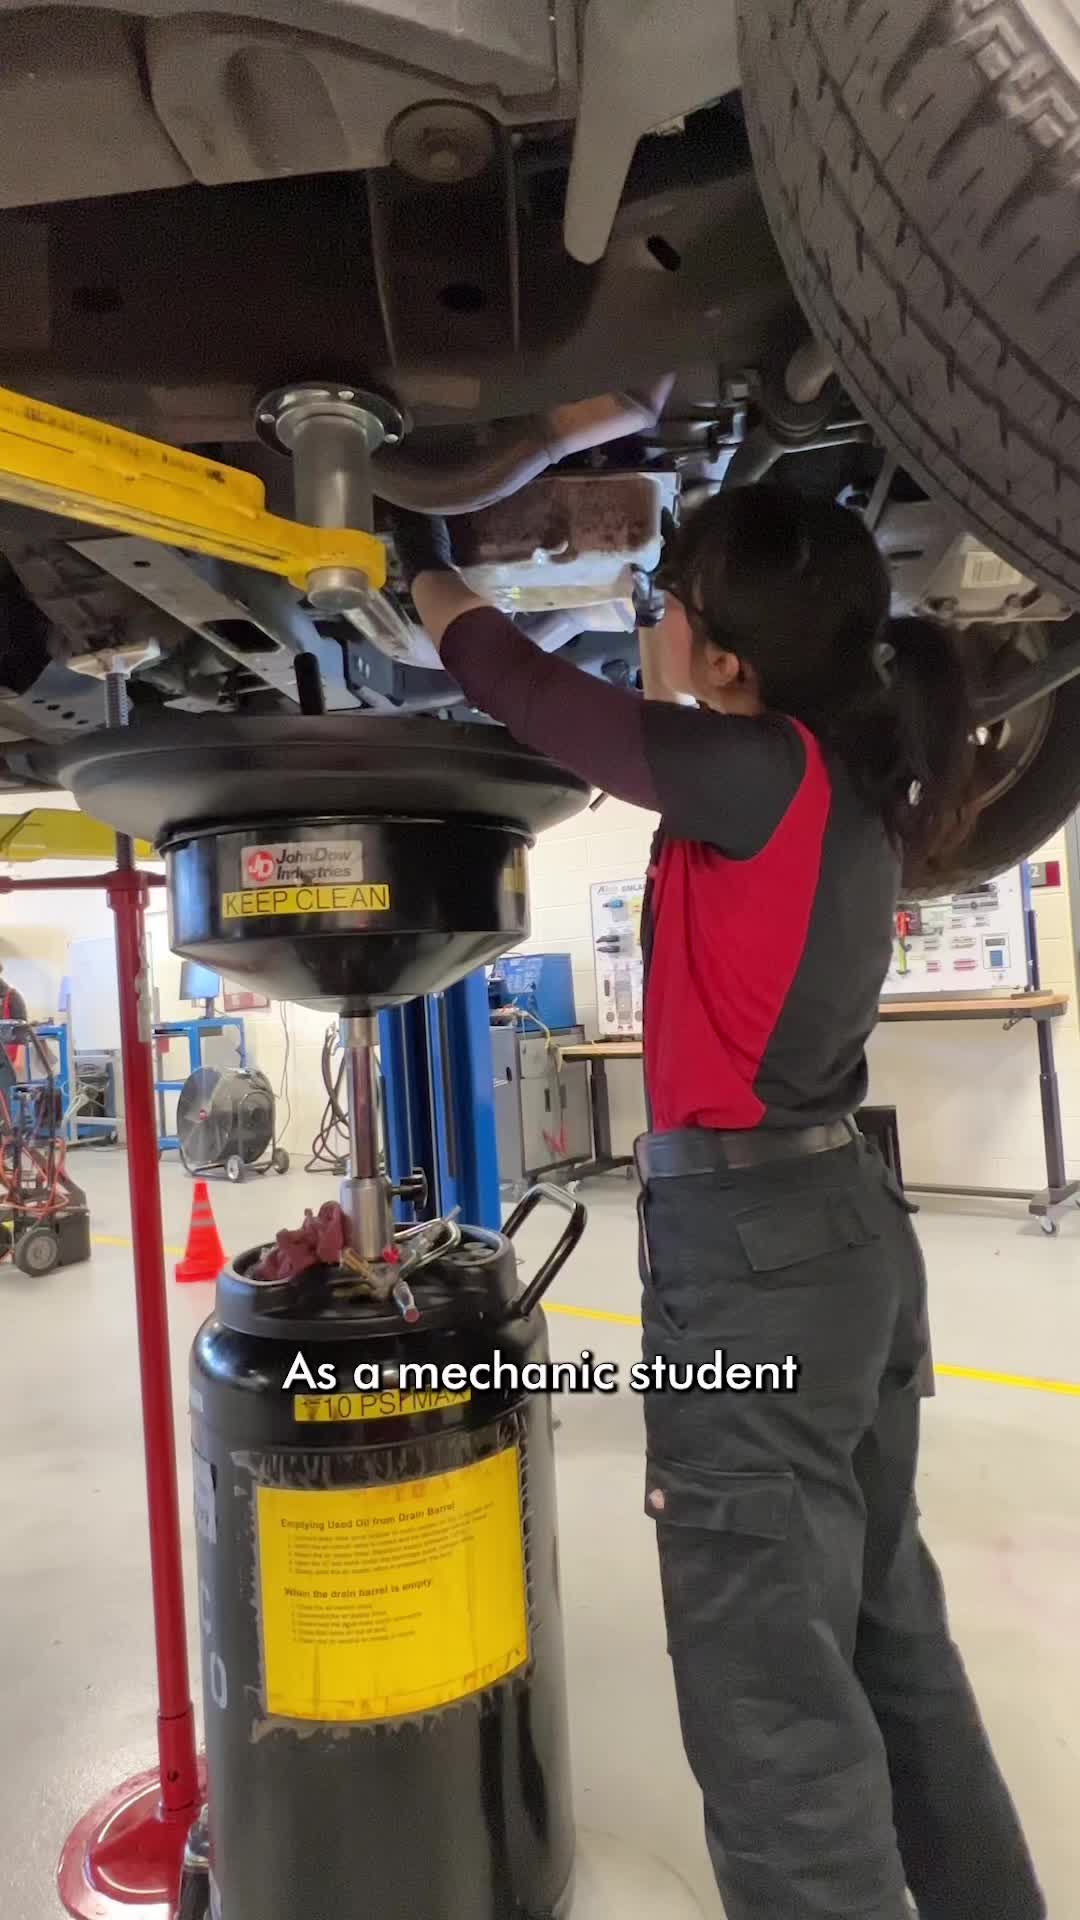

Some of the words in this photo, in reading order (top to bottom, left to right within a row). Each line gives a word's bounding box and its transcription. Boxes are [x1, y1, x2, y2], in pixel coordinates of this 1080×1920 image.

[276, 847, 352, 864] JohnDow
[277, 865, 352, 881] Industries
[225, 890, 288, 915] KEEP
[295, 886, 387, 911] CLEAN
[327, 1519, 353, 1529] Used
[372, 1516, 396, 1527] from
[398, 1511, 425, 1523] Drain
[426, 1501, 456, 1517] Barrel
[283, 1586, 311, 1599] When
[313, 1589, 328, 1599] the
[330, 1589, 357, 1599] drain
[359, 1585, 389, 1597] barrel
[391, 1583, 400, 1592] is
[401, 1578, 433, 1592] empty
